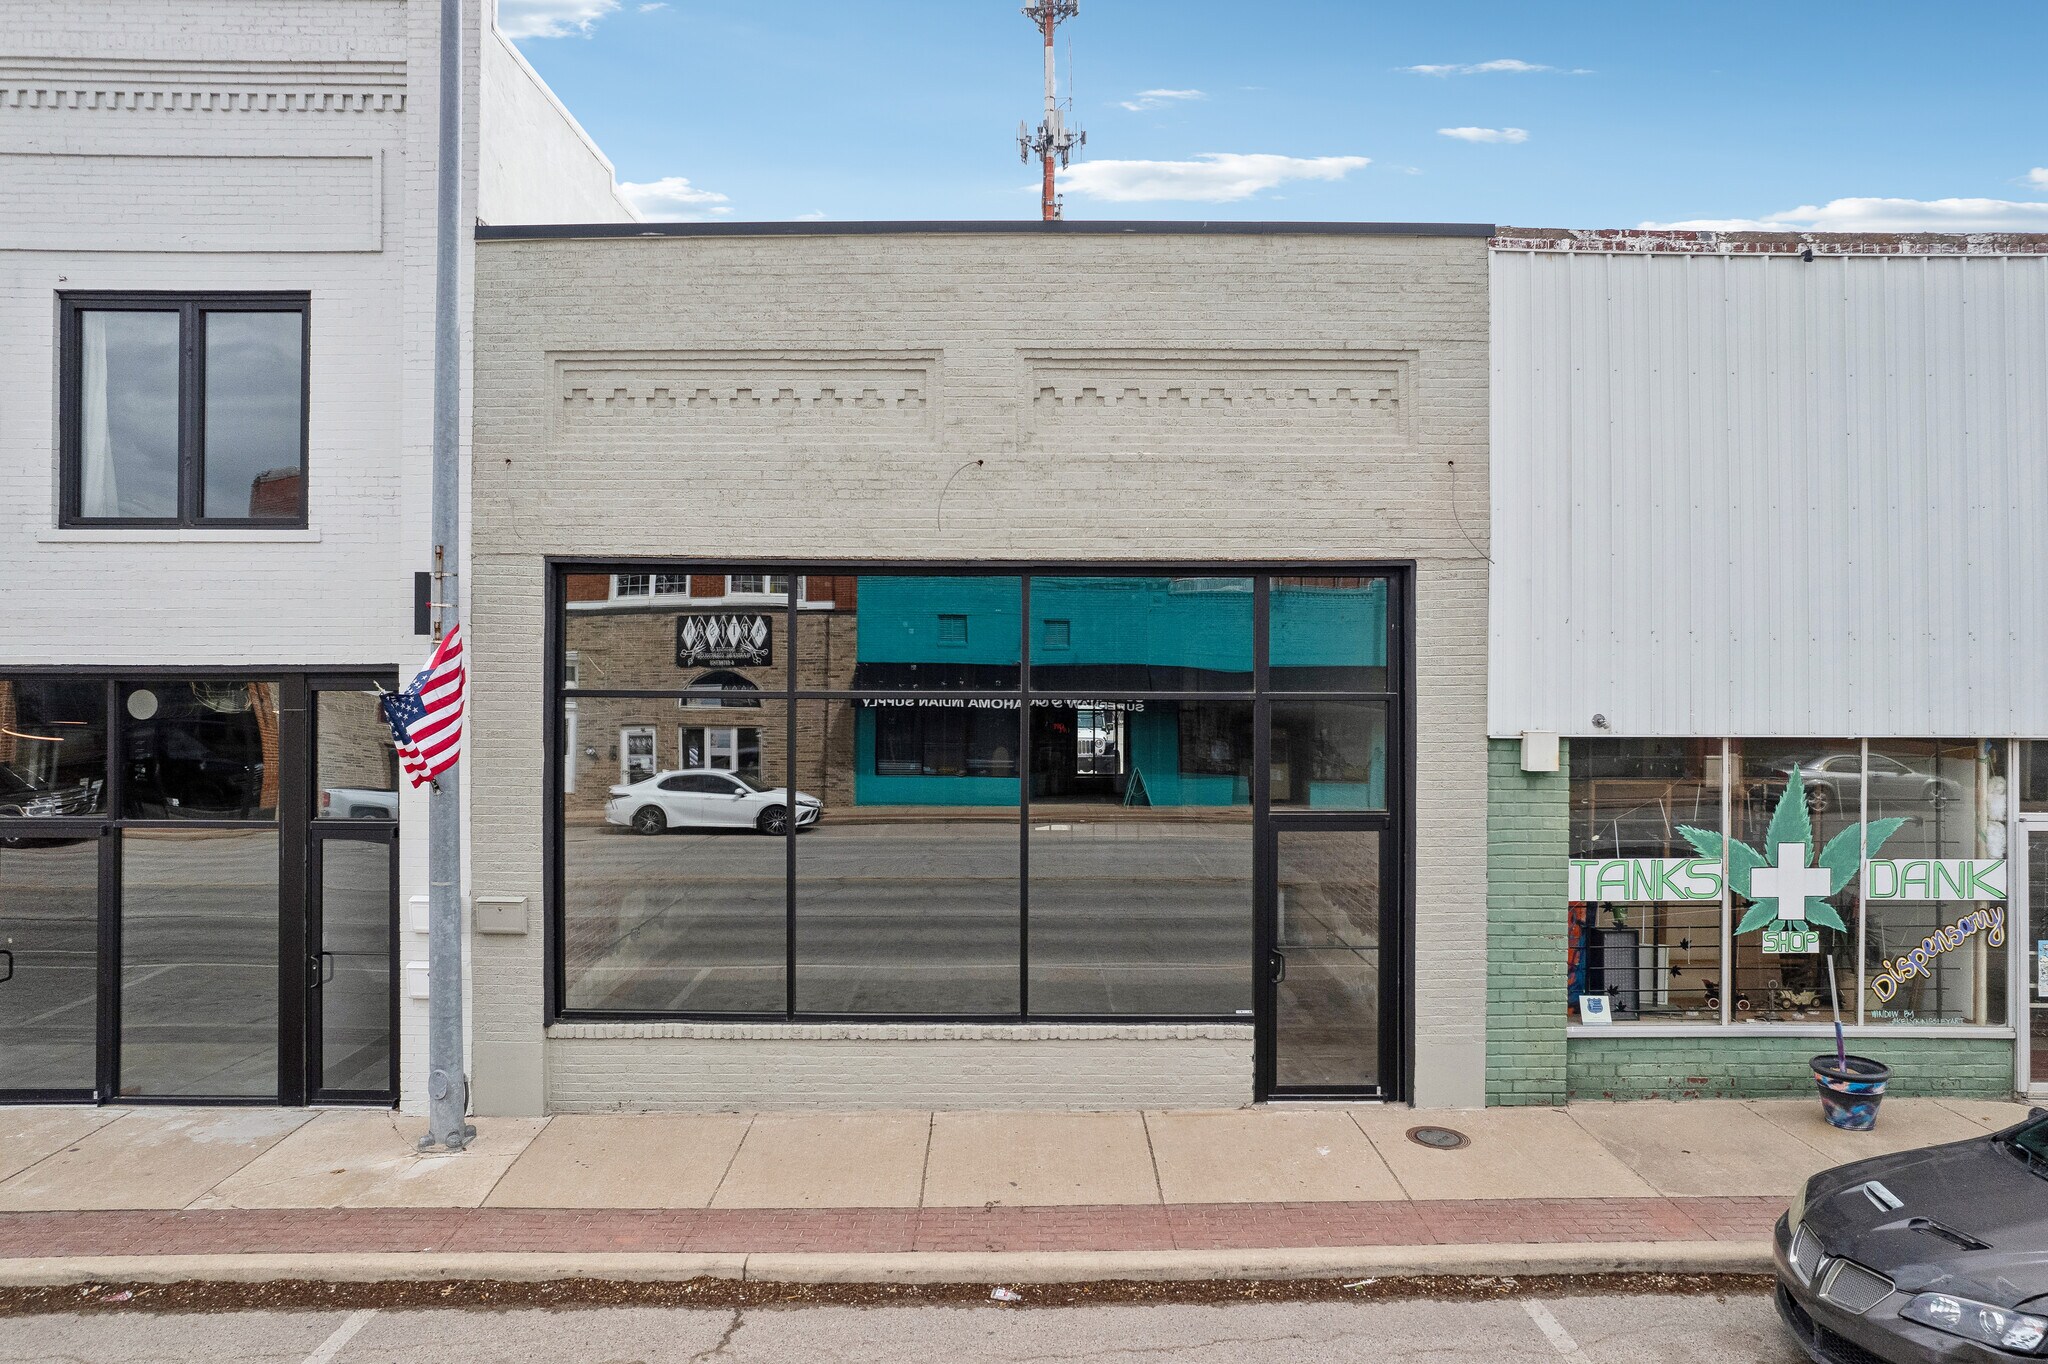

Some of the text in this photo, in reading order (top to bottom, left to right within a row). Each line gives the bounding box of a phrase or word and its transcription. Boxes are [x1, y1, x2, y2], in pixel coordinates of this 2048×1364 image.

[1570, 858, 2008, 900] TANKS DANK
[1763, 931, 1819, 953] SHOP
[1870, 906, 2005, 1003] Dispensary
